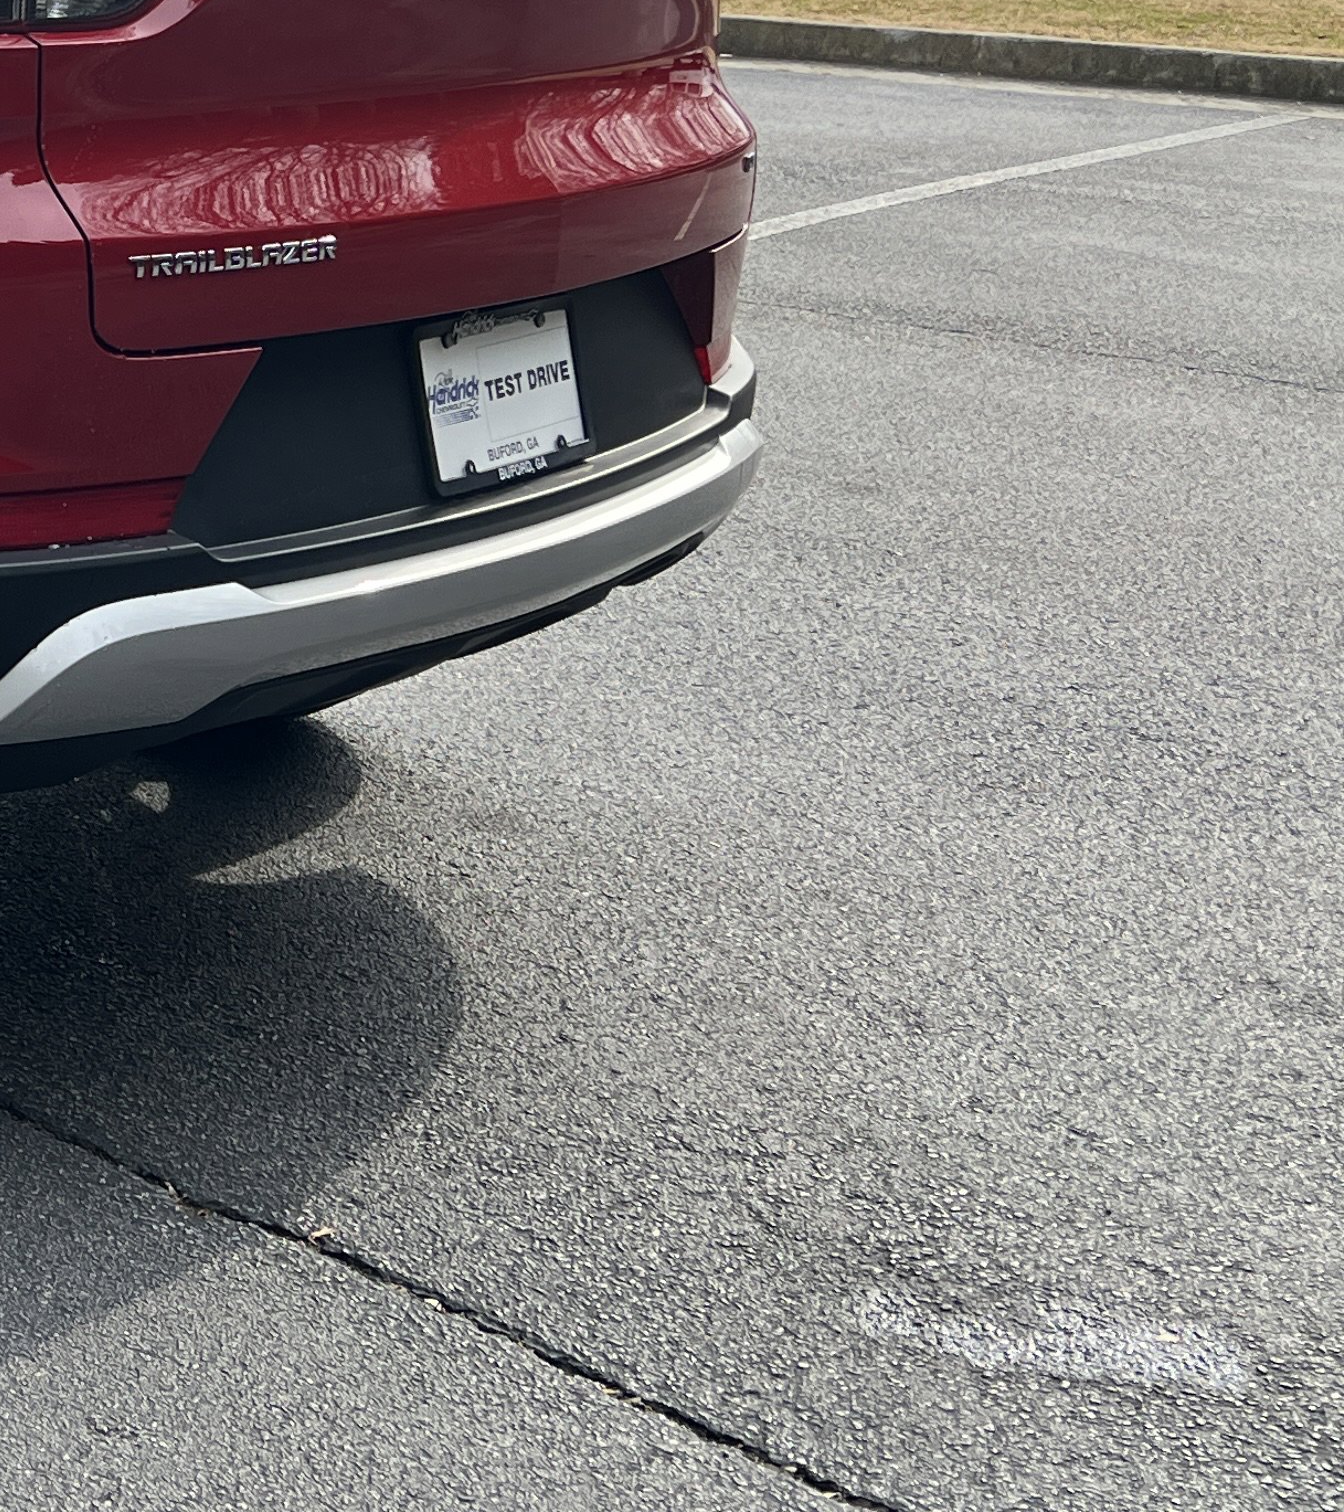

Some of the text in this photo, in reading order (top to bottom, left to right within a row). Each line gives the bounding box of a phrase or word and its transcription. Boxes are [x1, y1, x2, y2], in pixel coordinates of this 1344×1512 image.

[127, 234, 337, 279] TRAILBLAZER
[428, 375, 479, 415] Hendrick
[484, 359, 571, 402] TEST DRIVE
[487, 436, 540, 462] BUFORD, GA
[497, 455, 549, 481] BUFORD, GA
